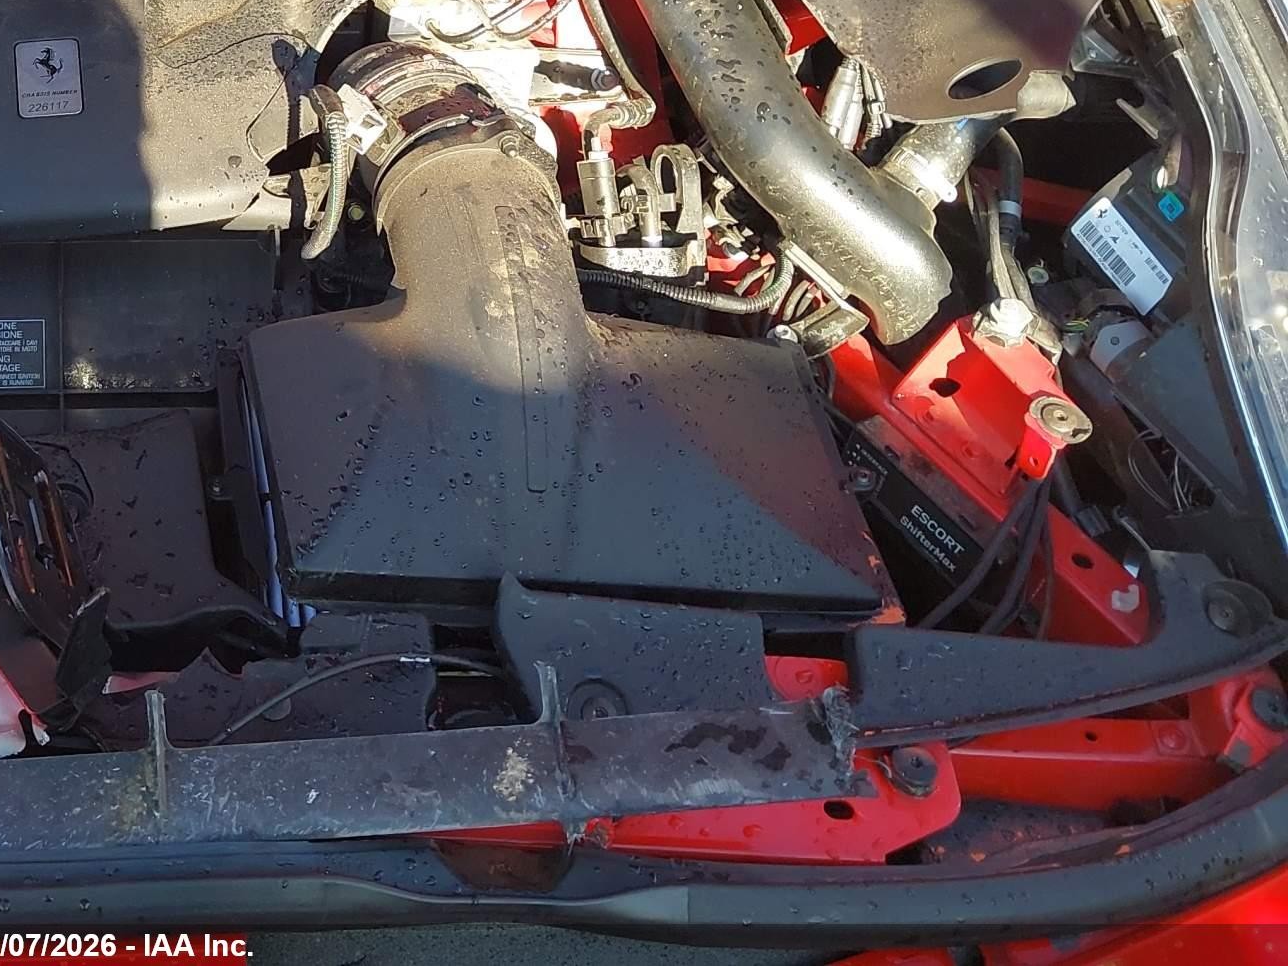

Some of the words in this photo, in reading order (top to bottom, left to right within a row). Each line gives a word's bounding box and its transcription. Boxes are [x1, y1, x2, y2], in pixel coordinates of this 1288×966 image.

[28, 100, 69, 113] 226117
[899, 515, 958, 573] ShifterMax
[910, 504, 965, 555] ESCORT
